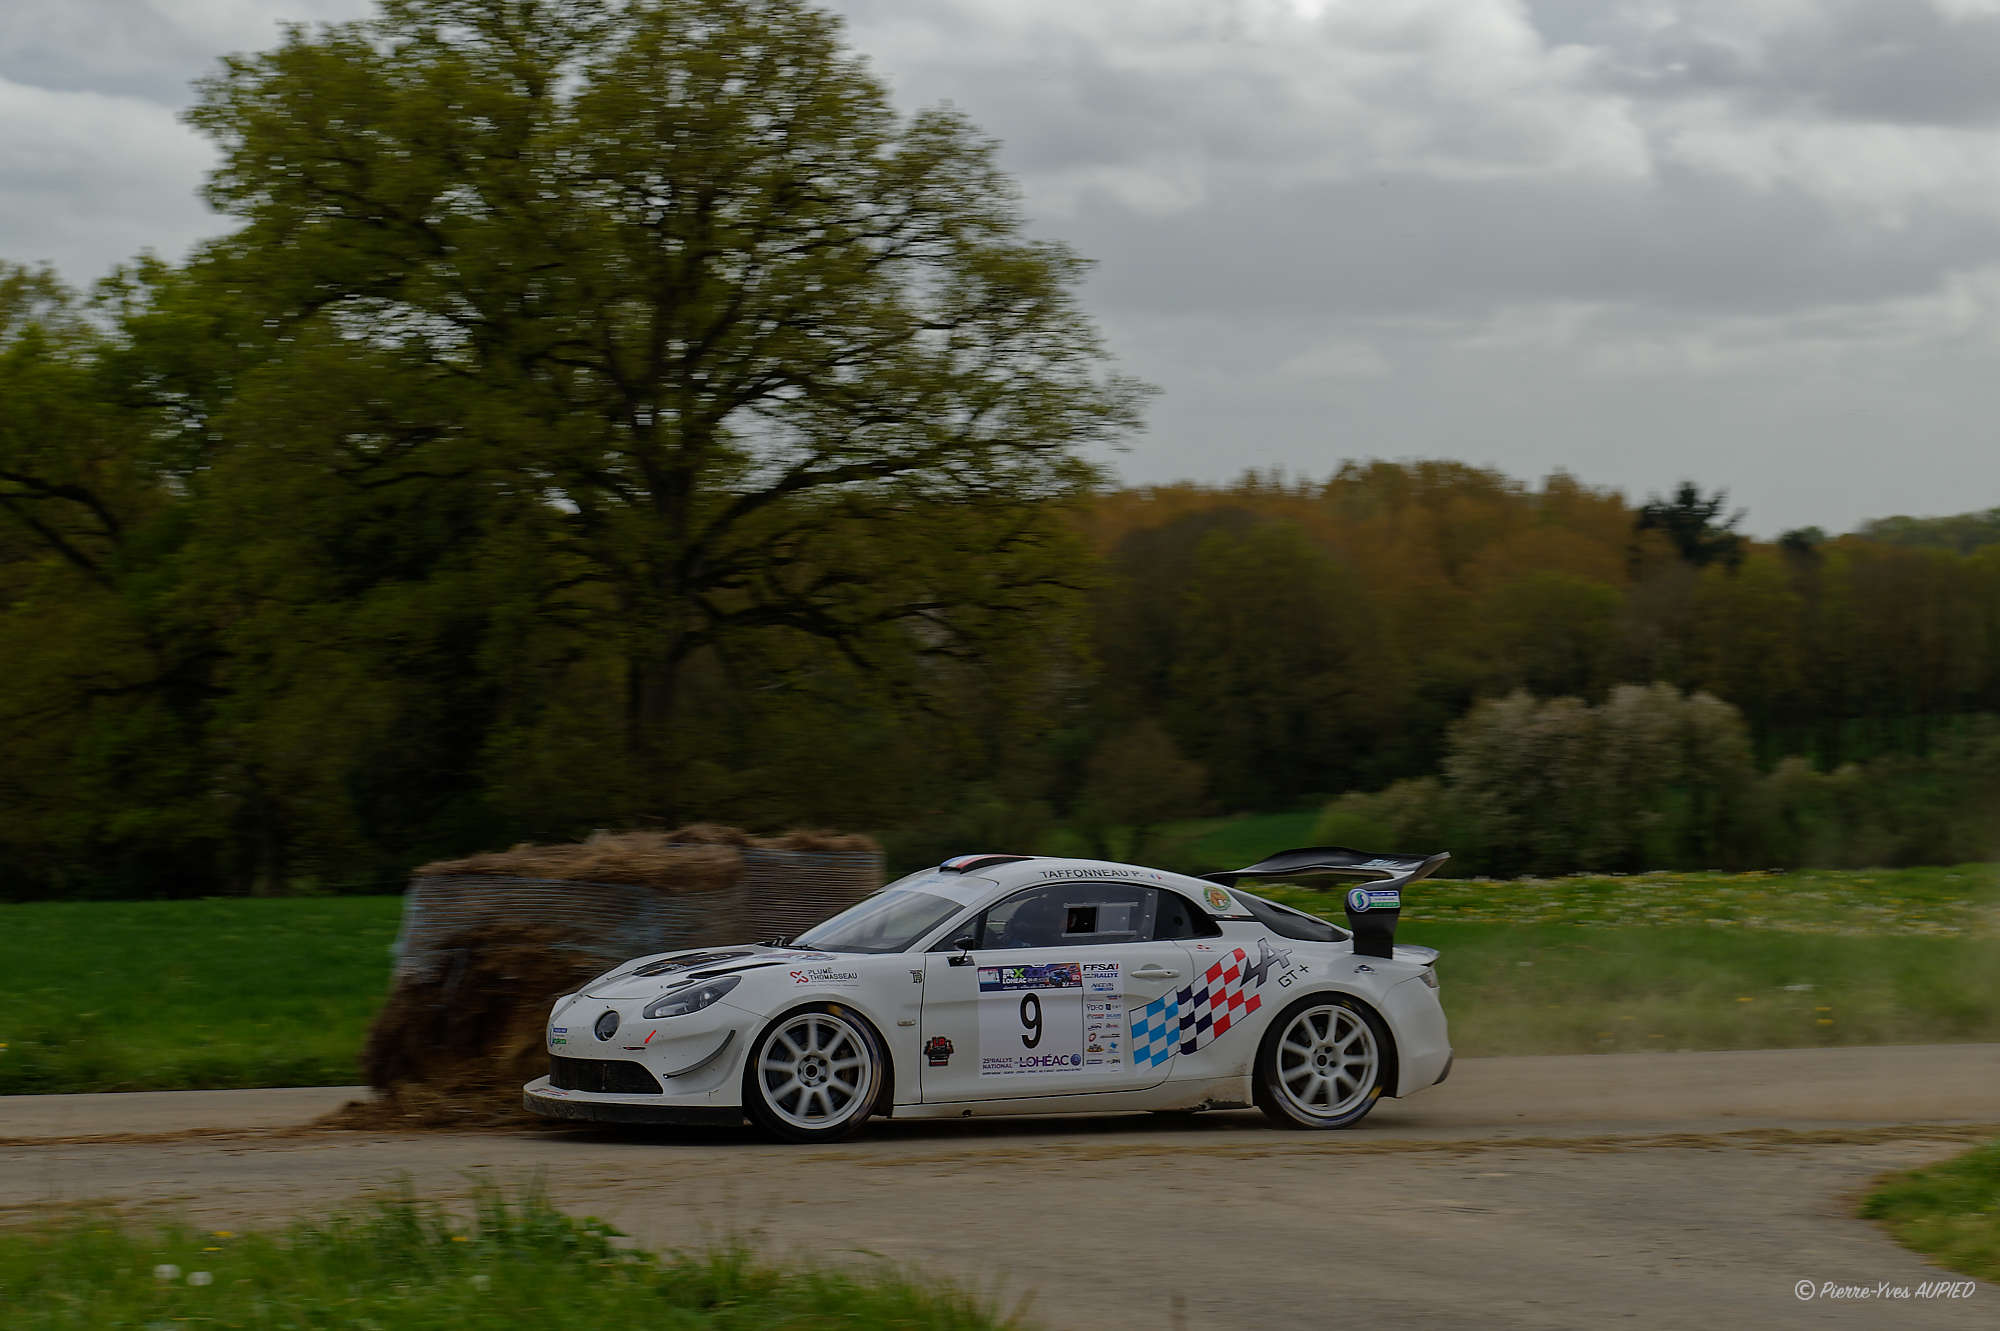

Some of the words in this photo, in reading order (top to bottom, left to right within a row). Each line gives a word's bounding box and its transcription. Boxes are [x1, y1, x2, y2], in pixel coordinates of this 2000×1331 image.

[1040, 869, 1128, 878] TAFFONNEAU
[1083, 963, 1115, 971] FFSA
[809, 972, 858, 981] THOMASSEAU
[1020, 992, 1043, 1049] 9
[1019, 1053, 1069, 1068] LOHÉAC
